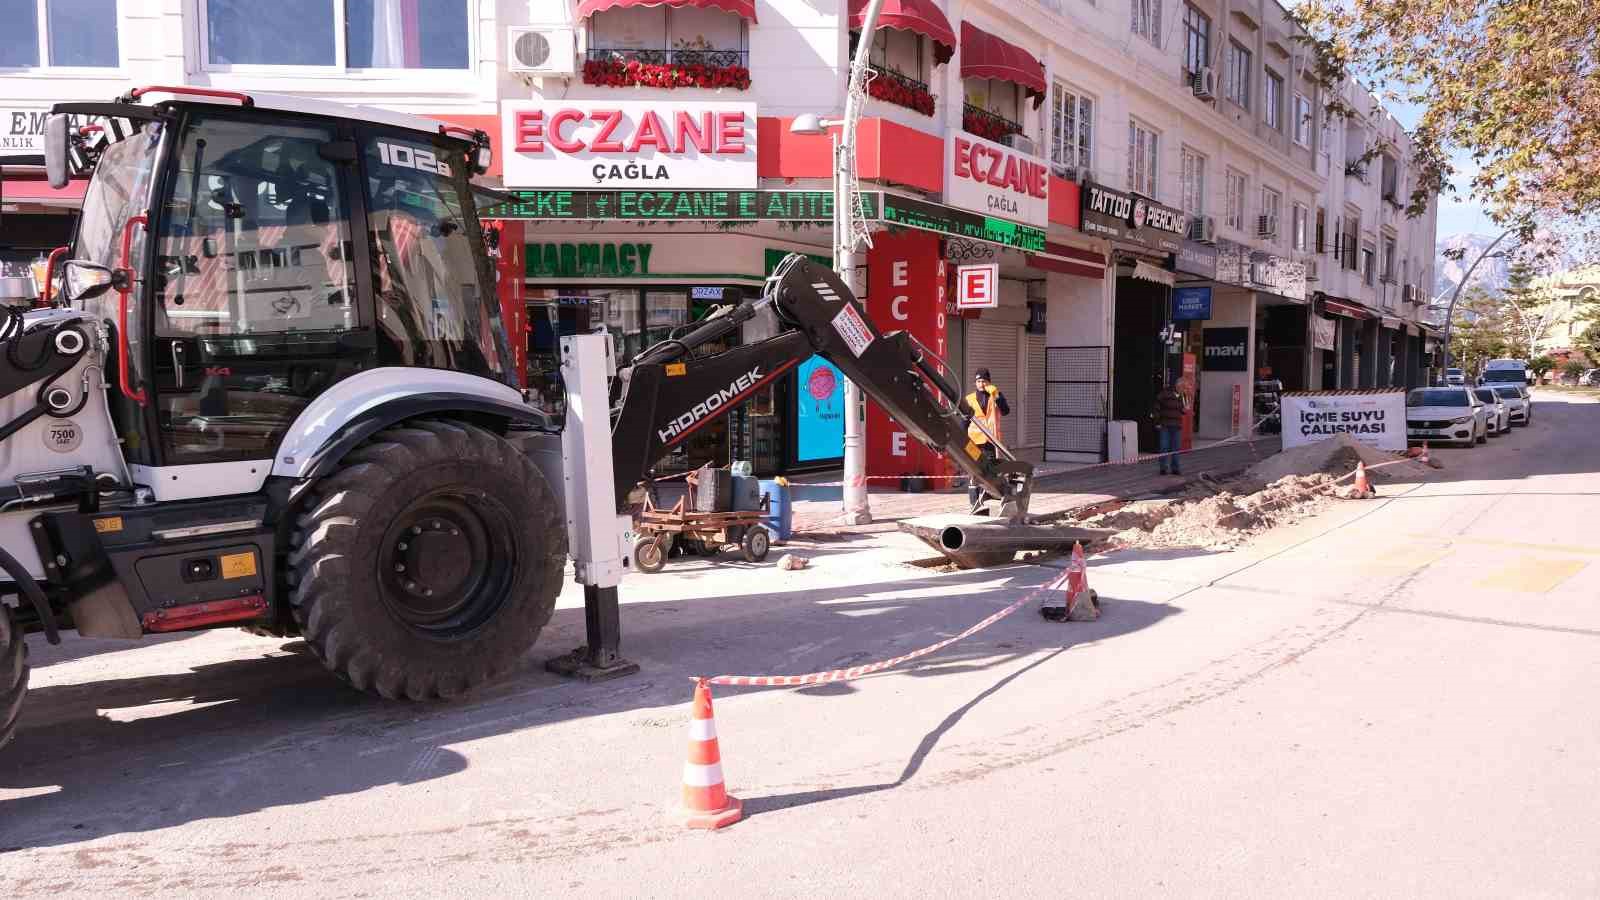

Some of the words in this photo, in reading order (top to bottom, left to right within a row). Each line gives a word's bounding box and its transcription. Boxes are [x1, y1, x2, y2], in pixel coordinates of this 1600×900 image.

[514, 109, 747, 154] ECZANE
[592, 161, 670, 184] ÇAĞLA
[954, 136, 1047, 199] ECZANE
[621, 192, 728, 216] ECZANE
[987, 194, 1018, 215] ÇAĞLA
[1090, 188, 1132, 220] TATTOO
[1146, 206, 1184, 234] PIERCING
[967, 275, 985, 298] E
[1204, 342, 1245, 356] mavi
[1300, 410, 1337, 424] İÇME
[1341, 410, 1384, 422] SUYU
[51, 430, 75, 440] 7500
